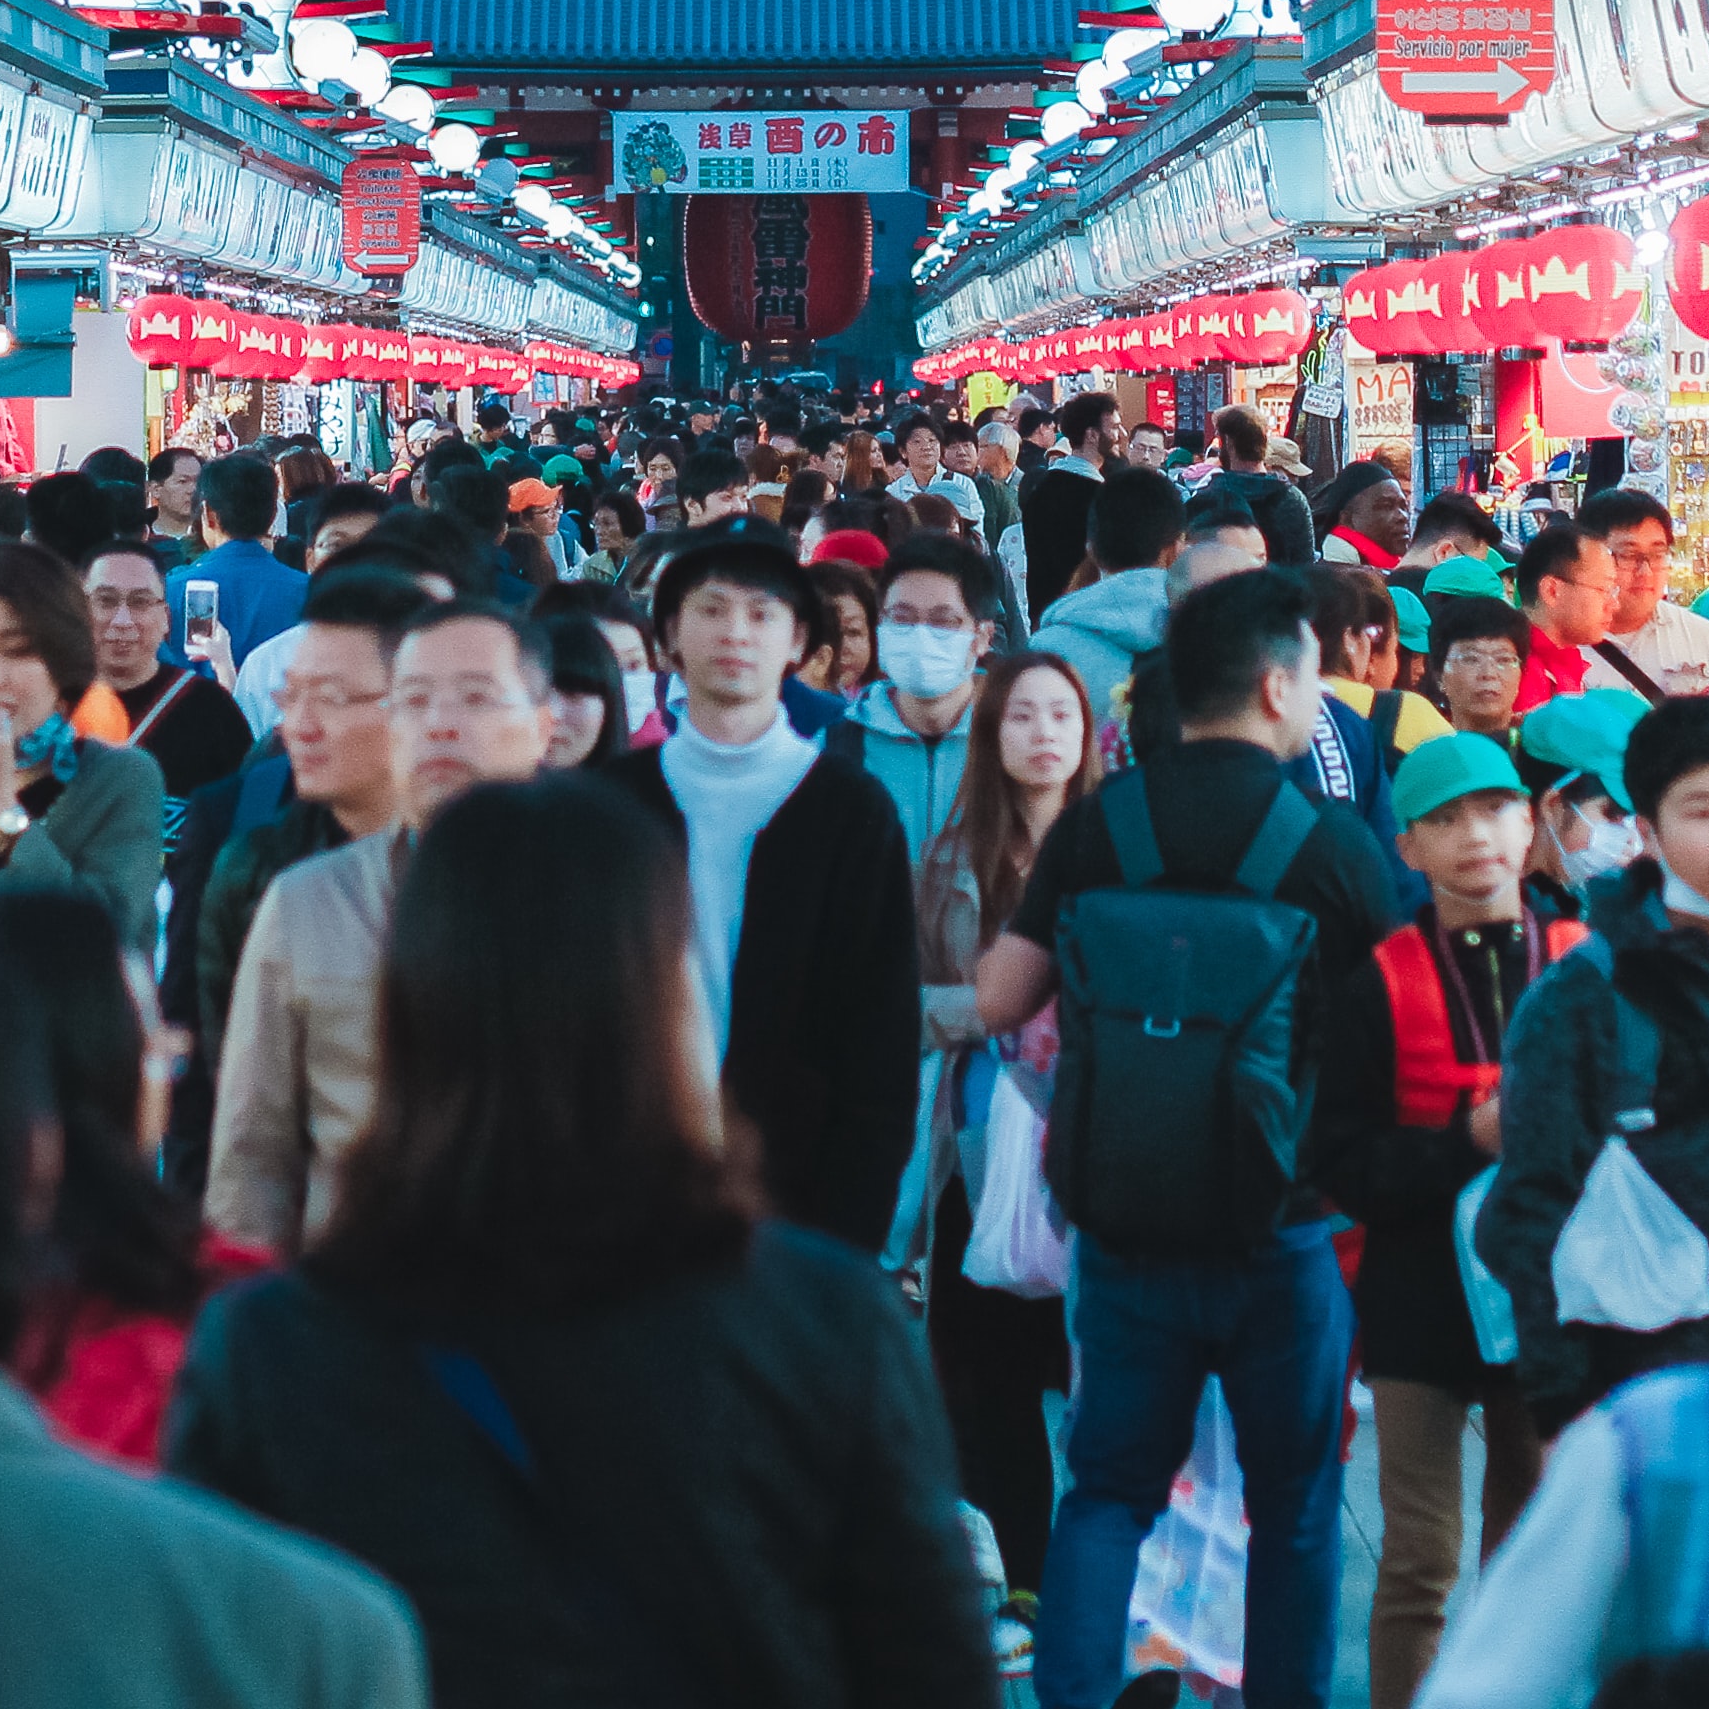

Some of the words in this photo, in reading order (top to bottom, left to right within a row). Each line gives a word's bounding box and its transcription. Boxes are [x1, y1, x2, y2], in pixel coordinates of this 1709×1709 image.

[1395, 36, 1452, 56] Servicio
[1458, 40, 1483, 60] por
[1488, 35, 1531, 58] mujer
